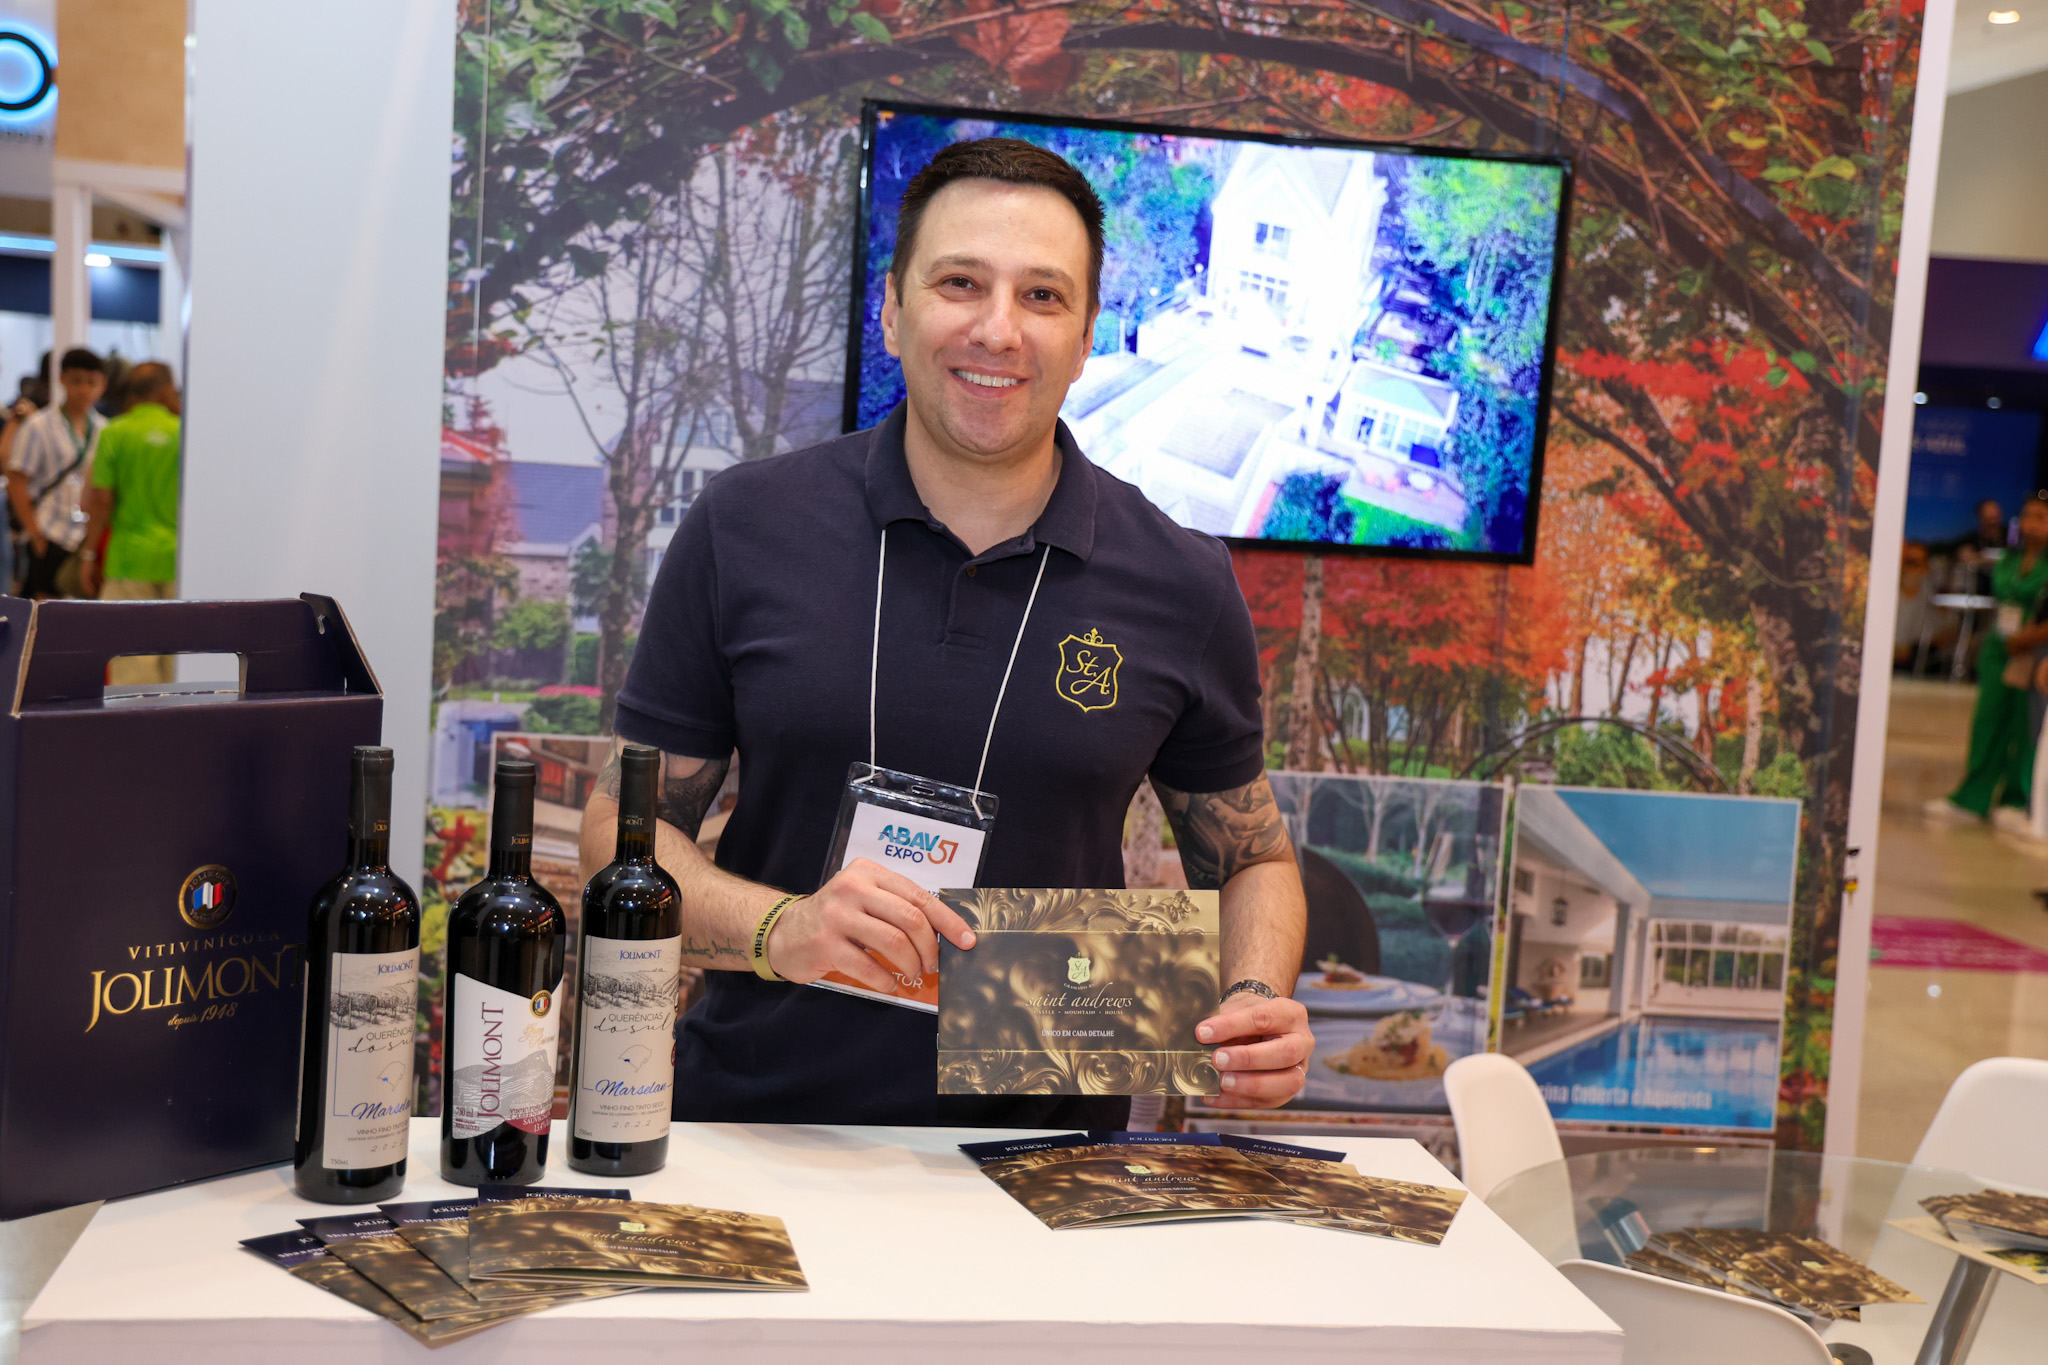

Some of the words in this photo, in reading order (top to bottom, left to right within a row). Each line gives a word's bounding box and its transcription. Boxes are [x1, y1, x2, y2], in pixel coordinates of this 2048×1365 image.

[878, 824, 940, 852] ABAV
[927, 839, 959, 865] 57
[884, 844, 924, 863] EXPO
[754, 897, 794, 958] BANQUETERIA
[128, 930, 281, 960] VITIVINÍCOLA
[619, 949, 663, 961] JOLIMONT
[84, 942, 307, 1034] JOLIMONT
[1025, 992, 1067, 1008] saint
[1071, 981, 1133, 1009] andrews
[167, 1013, 199, 1031] depuis
[200, 1001, 239, 1024] 1948
[609, 1011, 664, 1023] QUERÊNCIAS
[1041, 1028, 1061, 1037] ÚNICO
[1072, 1029, 1088, 1037] CADA
[1089, 1029, 1115, 1037] DETALHE
[477, 1001, 506, 1122] JOLIMONT
[595, 1079, 667, 1097] Marselan
